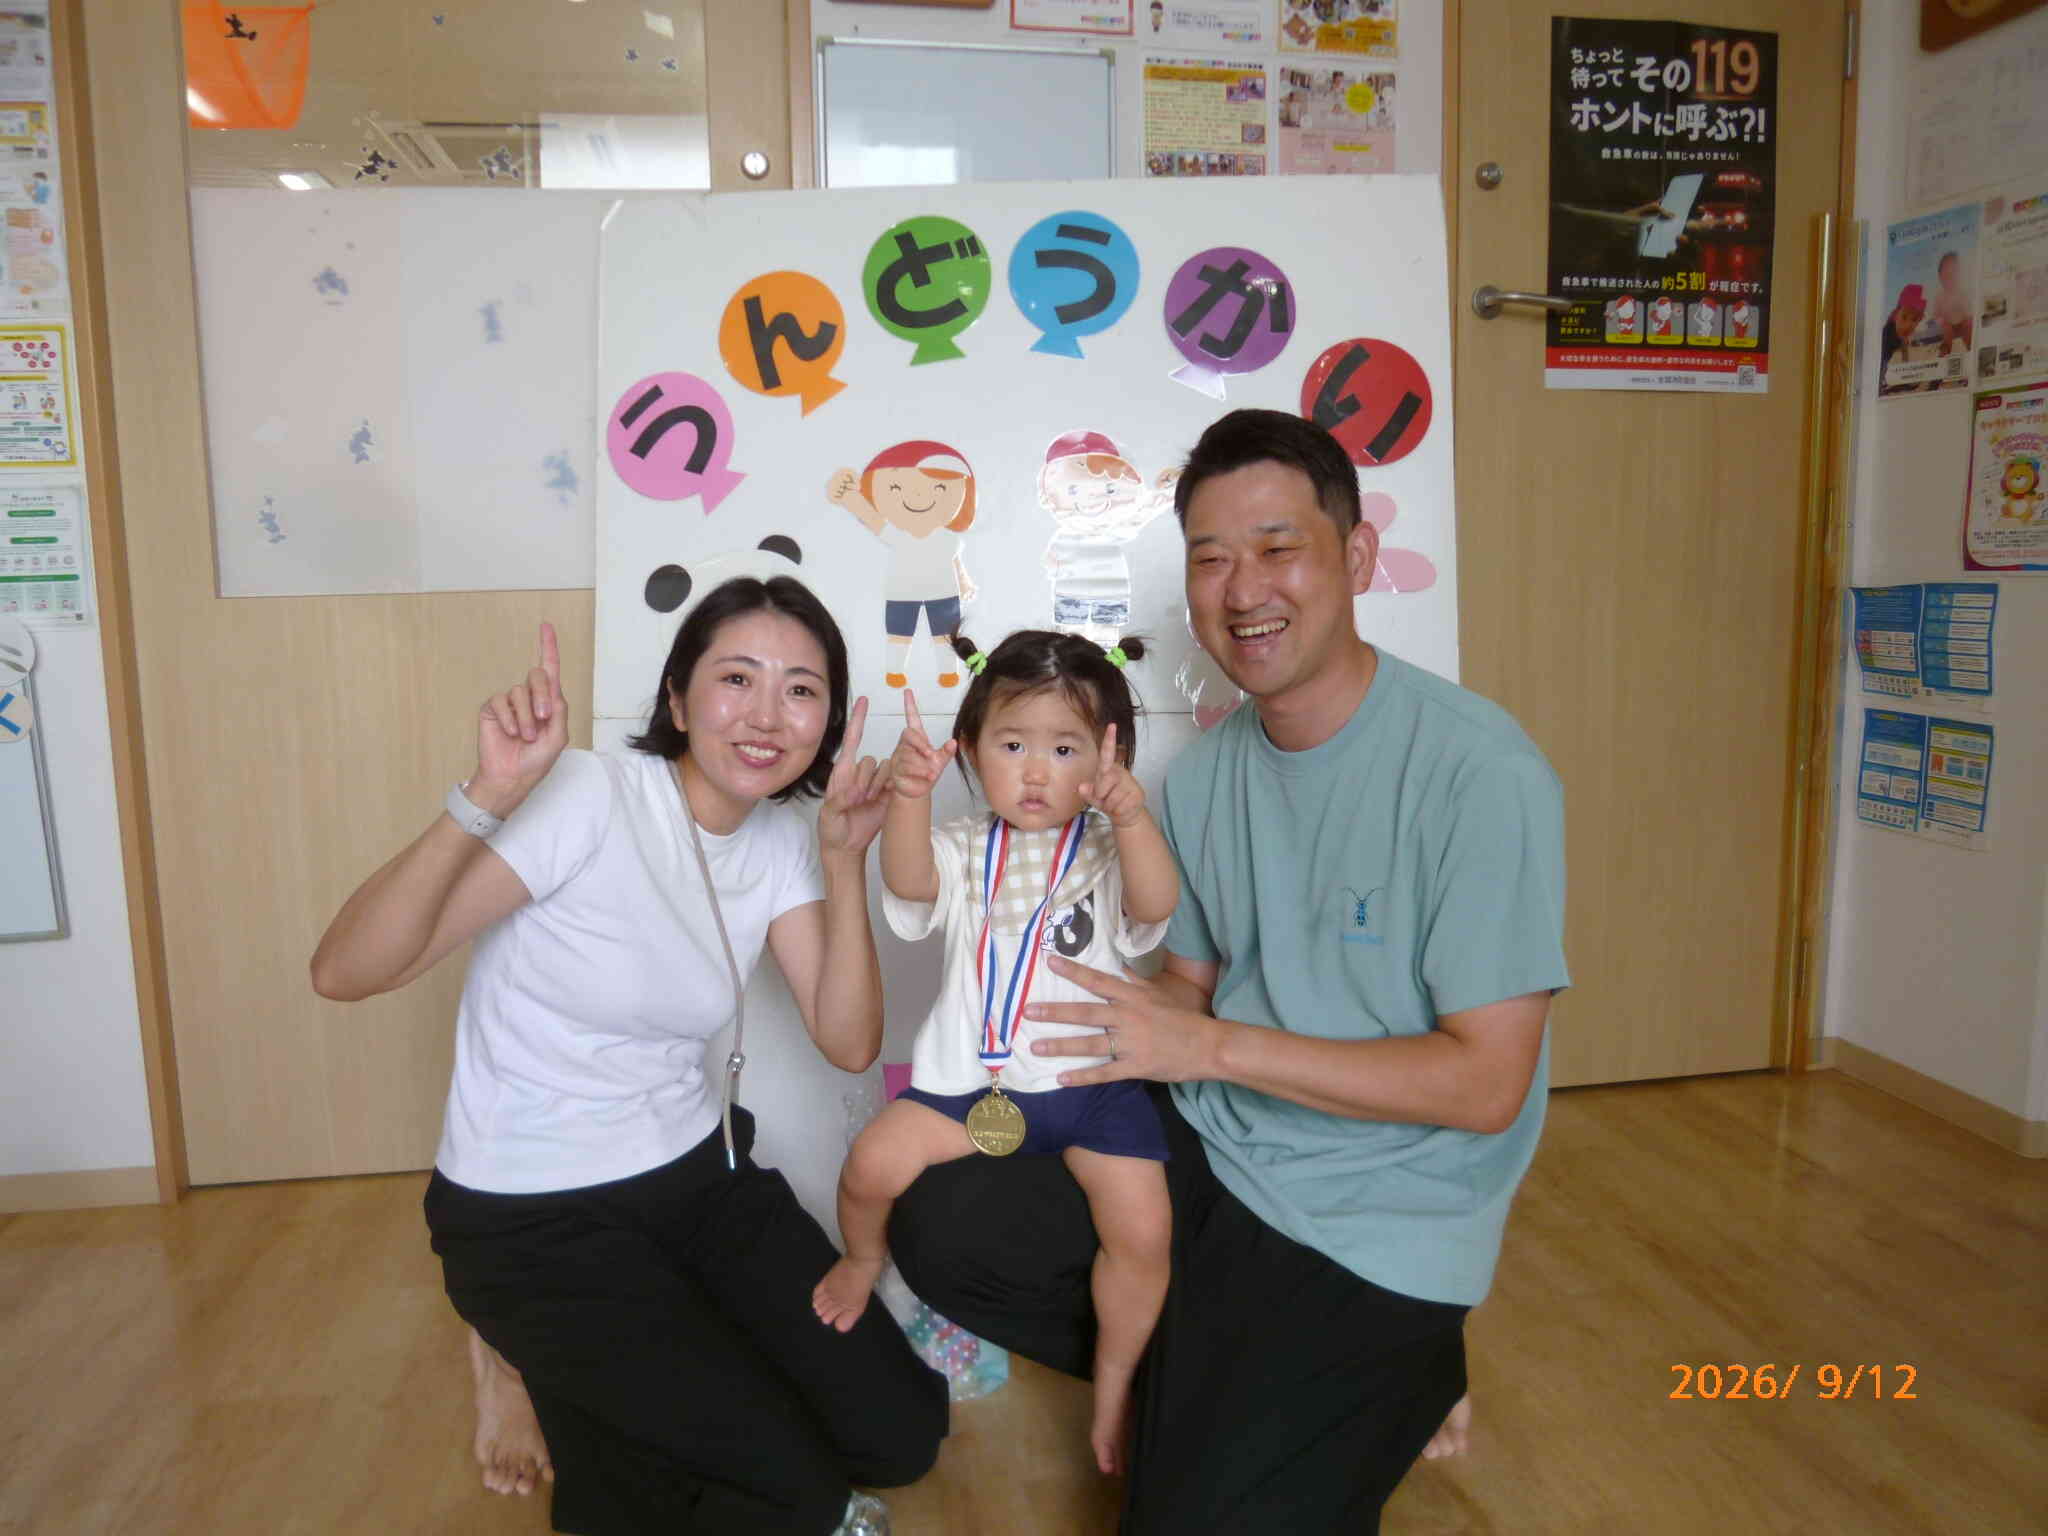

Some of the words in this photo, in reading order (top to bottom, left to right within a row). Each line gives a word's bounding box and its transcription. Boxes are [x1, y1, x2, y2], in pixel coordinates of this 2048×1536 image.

[1570, 48, 1624, 64] ちょっと
[1570, 67, 1625, 89] 待って
[1570, 97, 1766, 143] ホントに呼ぶ?!
